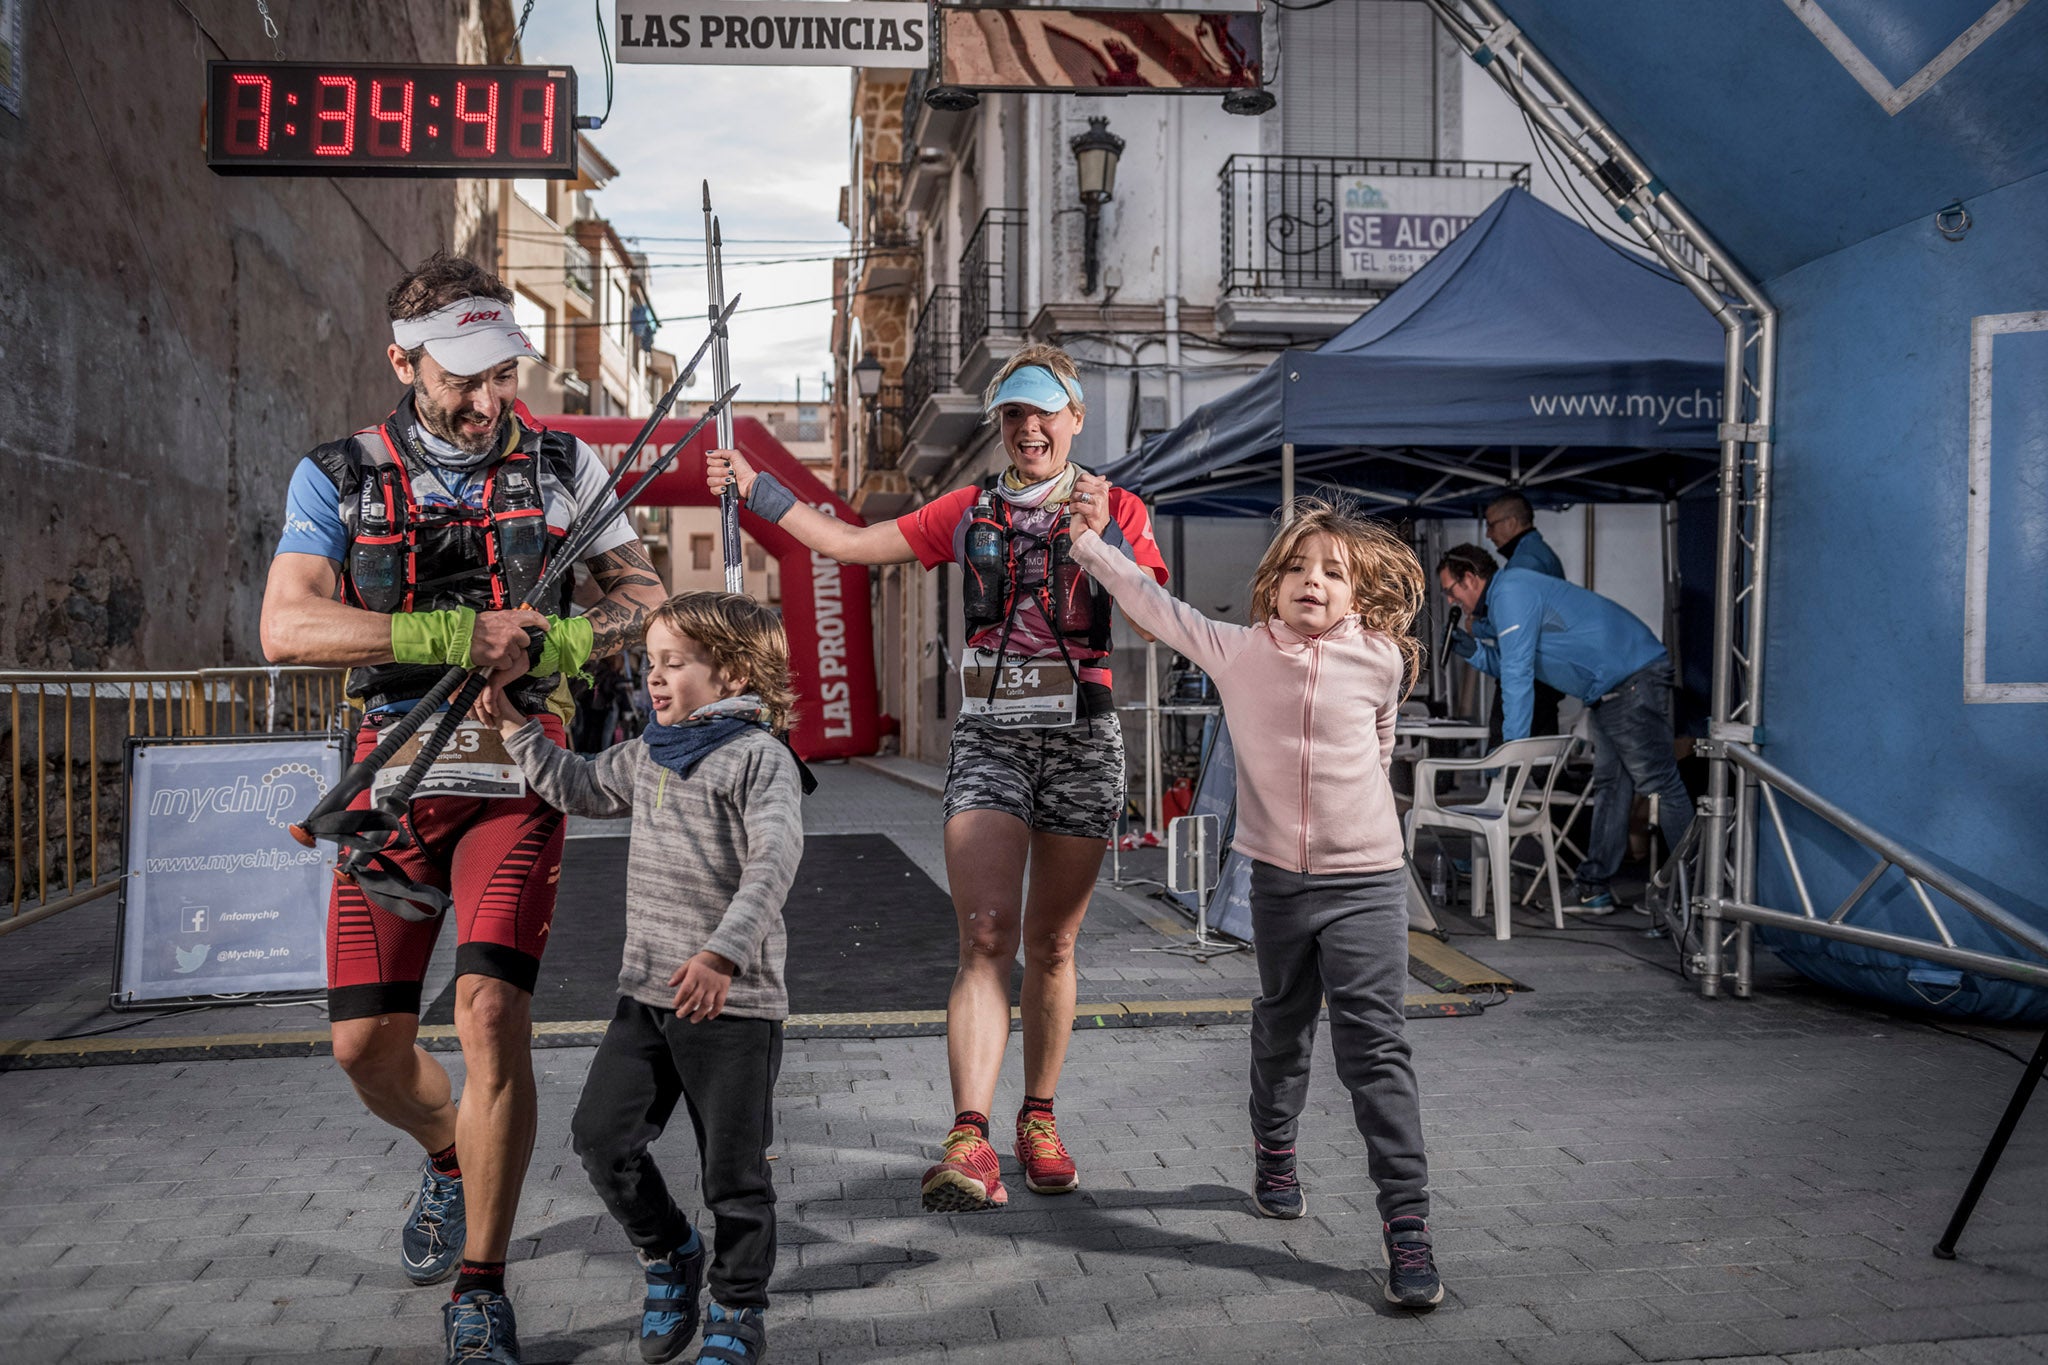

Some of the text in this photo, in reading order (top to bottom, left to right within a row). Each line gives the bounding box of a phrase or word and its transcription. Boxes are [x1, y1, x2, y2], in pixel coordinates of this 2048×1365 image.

[620, 14, 924, 51] LAS PROVINCIAS
[233, 73, 555, 156] 7:34:41
[1348, 216, 1474, 248] SE ALQU
[1530, 388, 1726, 426] www.mychi
[808, 501, 853, 739] LAS PROVINCS
[437, 752, 462, 763] eriquito
[149, 775, 297, 823] mychip
[146, 848, 322, 874] www.mychip.es
[217, 946, 290, 963] @Mychip_Info
